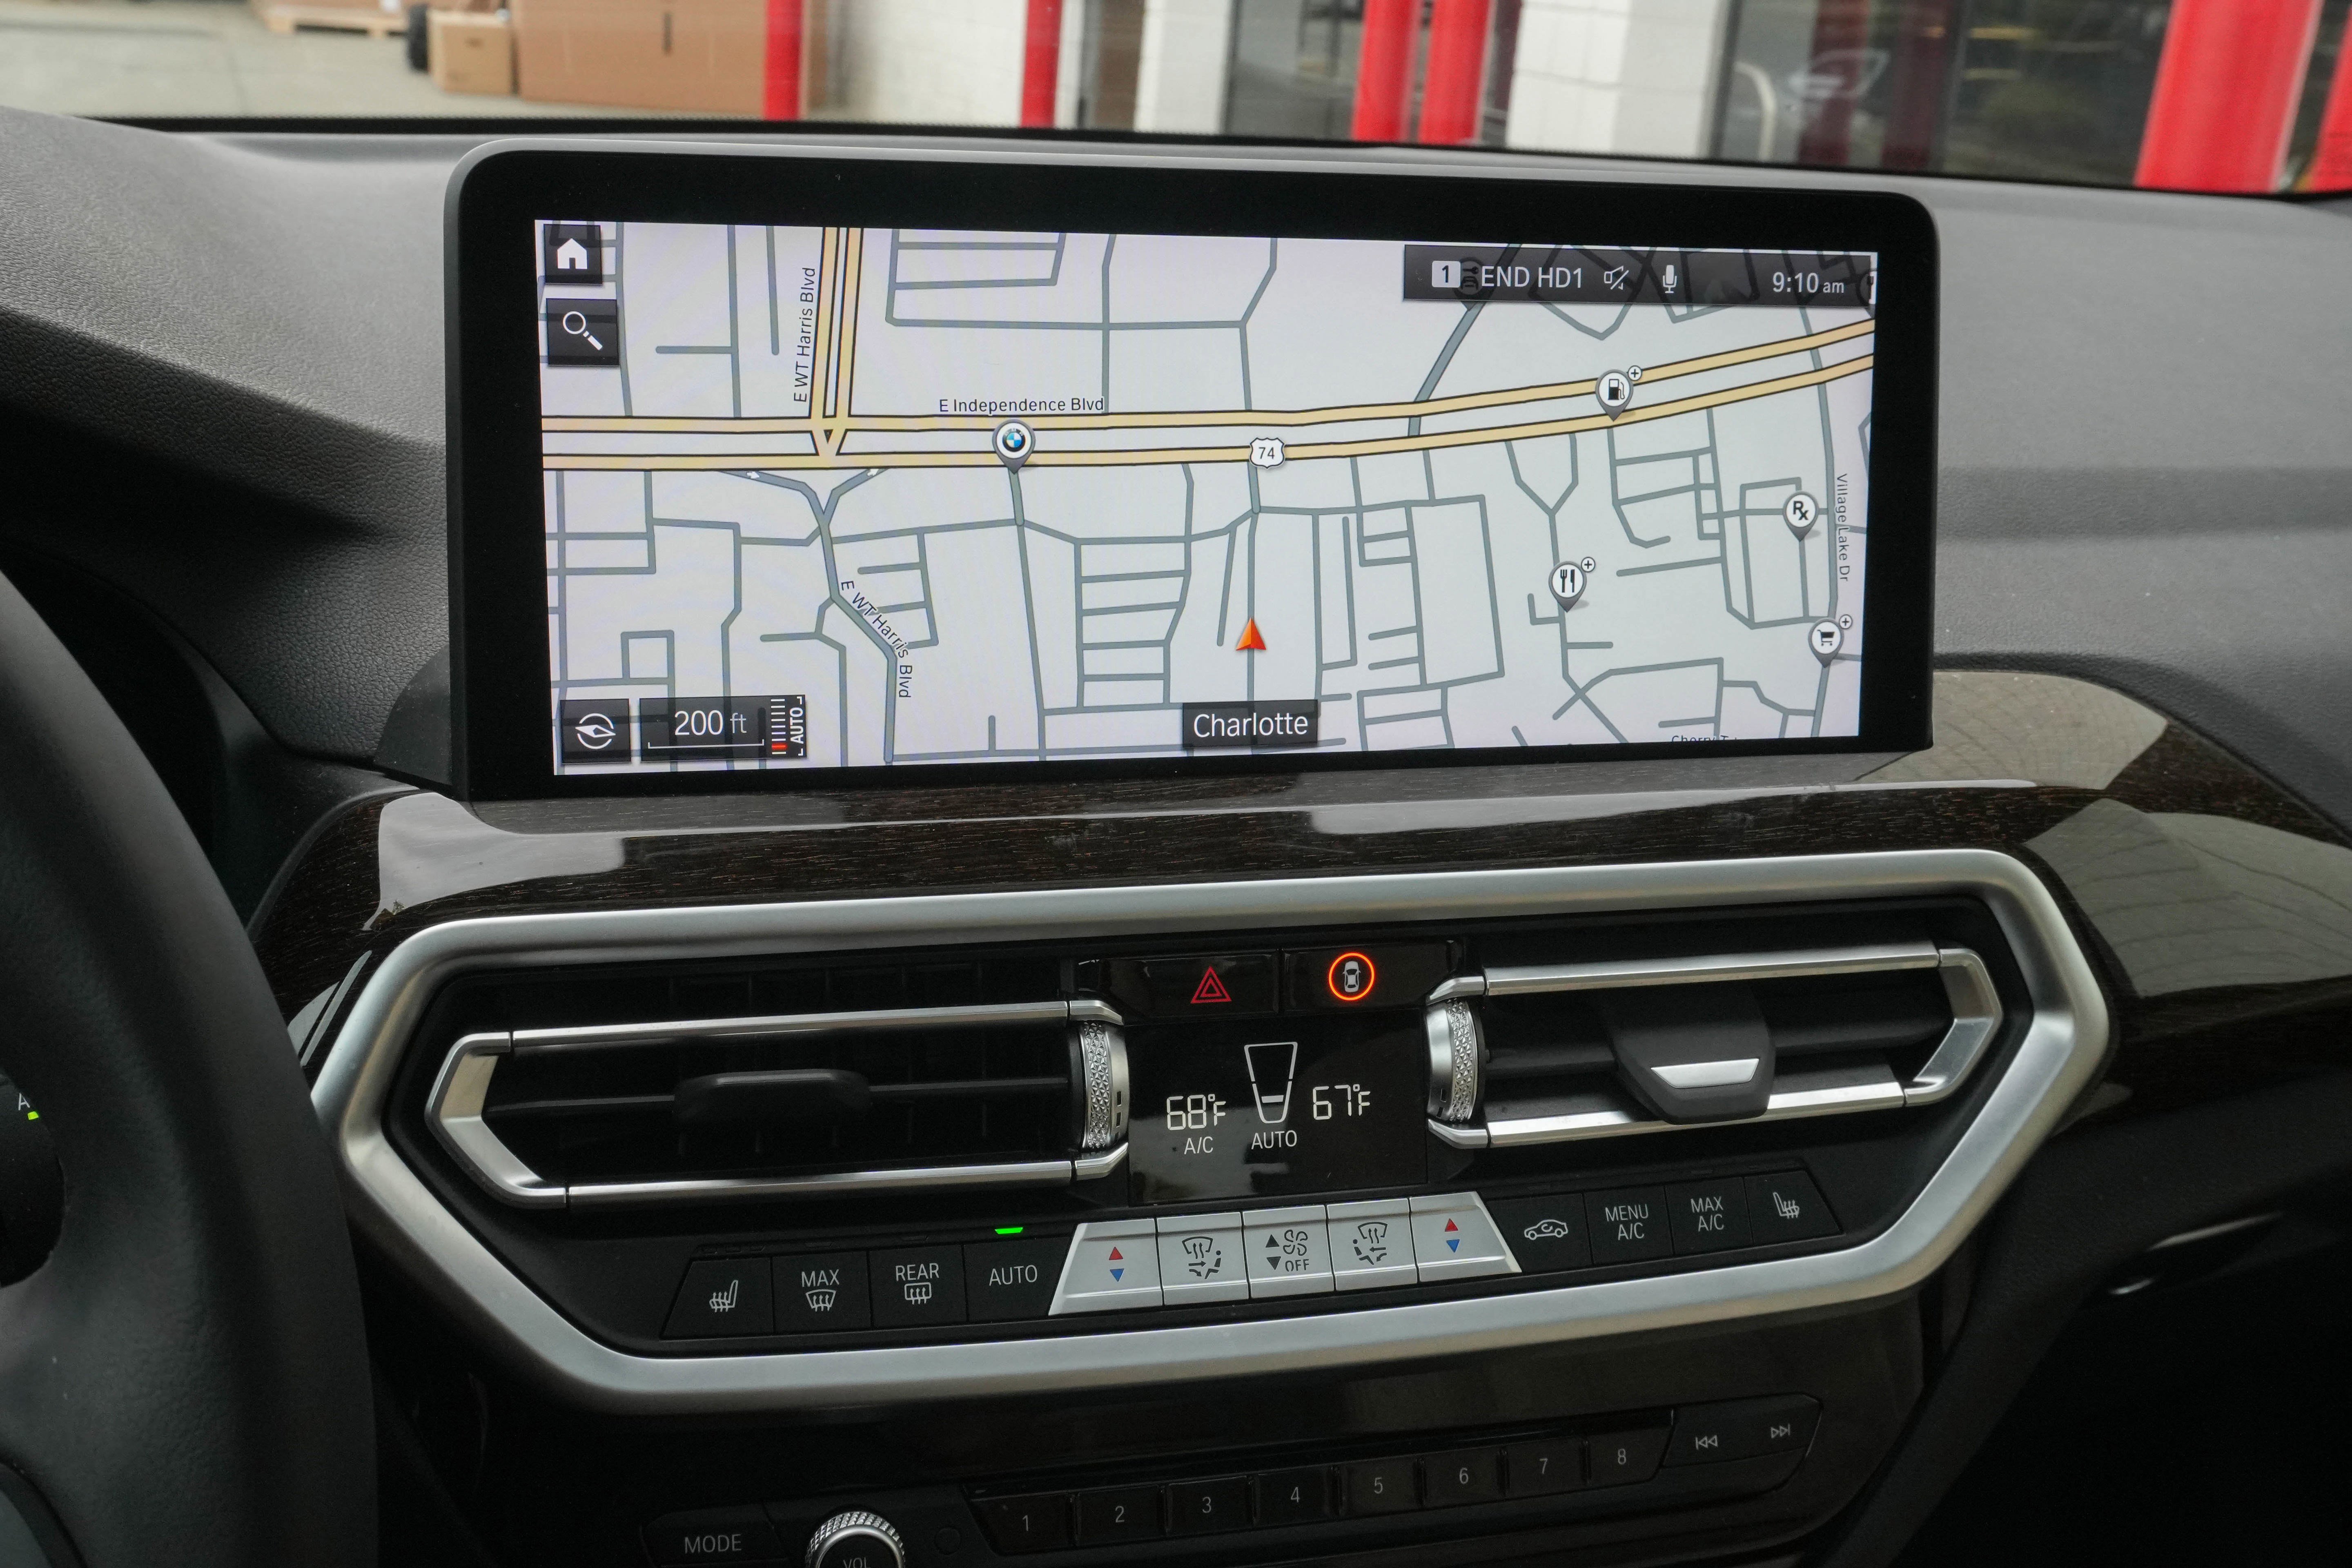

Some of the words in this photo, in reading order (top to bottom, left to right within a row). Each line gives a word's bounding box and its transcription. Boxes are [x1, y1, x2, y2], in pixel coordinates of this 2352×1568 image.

[800, 267, 815, 303] Blvd
[1442, 265, 1449, 283] 1
[1481, 266, 1530, 287] END
[1538, 267, 1583, 289] HD1
[1773, 272, 1819, 293] 9:10
[1823, 282, 1844, 294] am
[797, 308, 813, 356] Harris
[795, 361, 808, 388] WT
[794, 392, 807, 402] E
[940, 399, 949, 412] E
[954, 398, 1065, 414] Independence
[1071, 397, 1104, 410] Blvd
[1258, 447, 1275, 459] 74
[1835, 473, 1848, 523] Village
[1838, 528, 1849, 561] Lake
[1840, 566, 1850, 581] Dr
[841, 581, 855, 591] E
[852, 592, 877, 616] WT
[872, 615, 908, 659] Harris
[899, 665, 913, 698] Blvd
[675, 710, 724, 736] 200
[730, 712, 747, 734] ft
[790, 707, 804, 744] AUTO
[1194, 713, 1308, 737] Charlotte
[18, 1093, 30, 1111] A
[1184, 1136, 1213, 1154] A/C
[1251, 1130, 1297, 1149] AUTO
[1605, 1204, 1648, 1221] MENU
[1690, 1196, 1724, 1213] MAX
[1617, 1222, 1645, 1240] A/C
[1698, 1214, 1724, 1232] A/C
[895, 1263, 939, 1281] REAR
[1285, 1258, 1310, 1272] OFF
[802, 1269, 840, 1287] MAX
[989, 1265, 1038, 1286] AUTO
[1617, 1448, 1627, 1465] 8
[1539, 1458, 1548, 1474] 7
[1459, 1468, 1469, 1484] 6
[1374, 1477, 1383, 1494] 5
[1290, 1487, 1300, 1503] 4
[1202, 1497, 1212, 1513] 3
[1022, 1515, 1029, 1531] 1
[1115, 1506, 1125, 1523] 2
[685, 1534, 742, 1553] MODE
[843, 1557, 871, 1568] VOL
